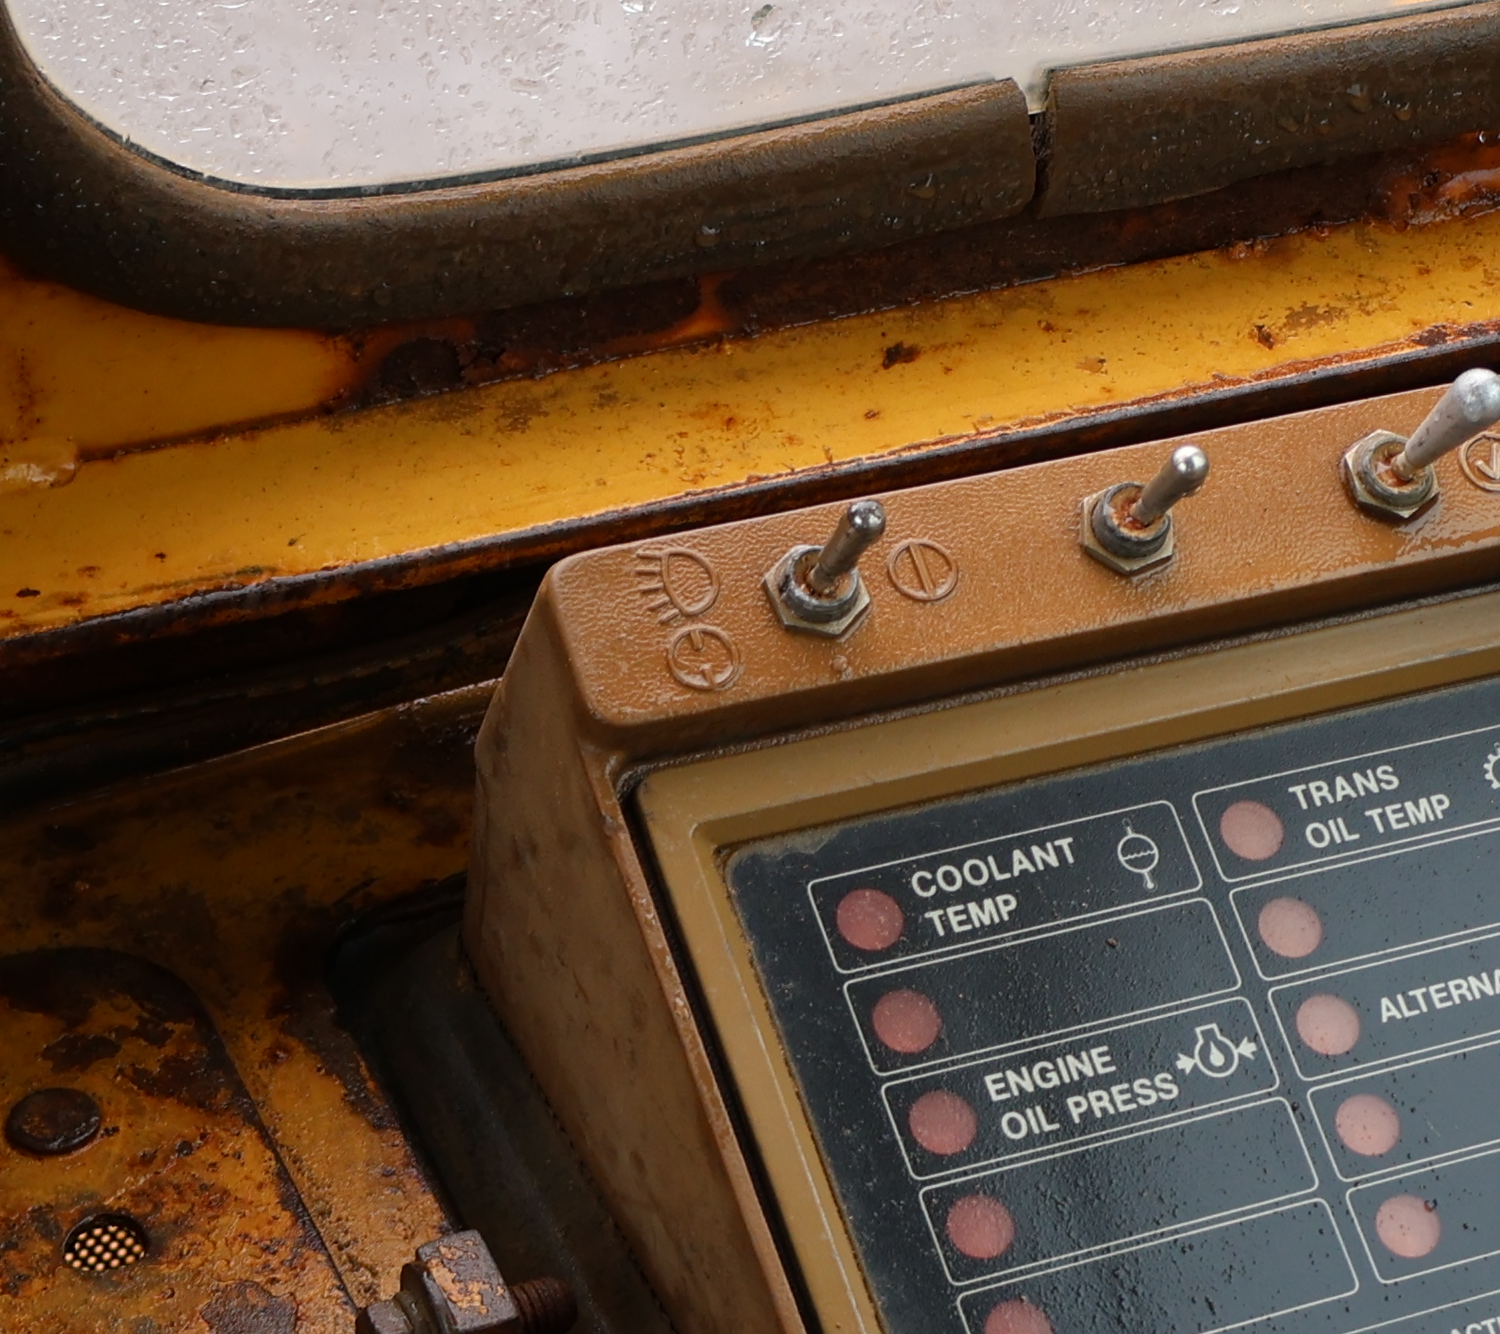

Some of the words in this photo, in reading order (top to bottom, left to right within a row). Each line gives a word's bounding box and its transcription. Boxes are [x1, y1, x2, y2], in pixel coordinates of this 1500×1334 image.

[1288, 764, 1400, 810] TRANS
[1305, 817, 1360, 849] OIL
[1364, 793, 1451, 834] TEMP
[911, 837, 1074, 898] COOLANT
[924, 893, 1018, 937] TEMP
[984, 1045, 1117, 1102] ENGINE
[1001, 1105, 1060, 1140] OIL
[1066, 1072, 1179, 1124] PRESS
